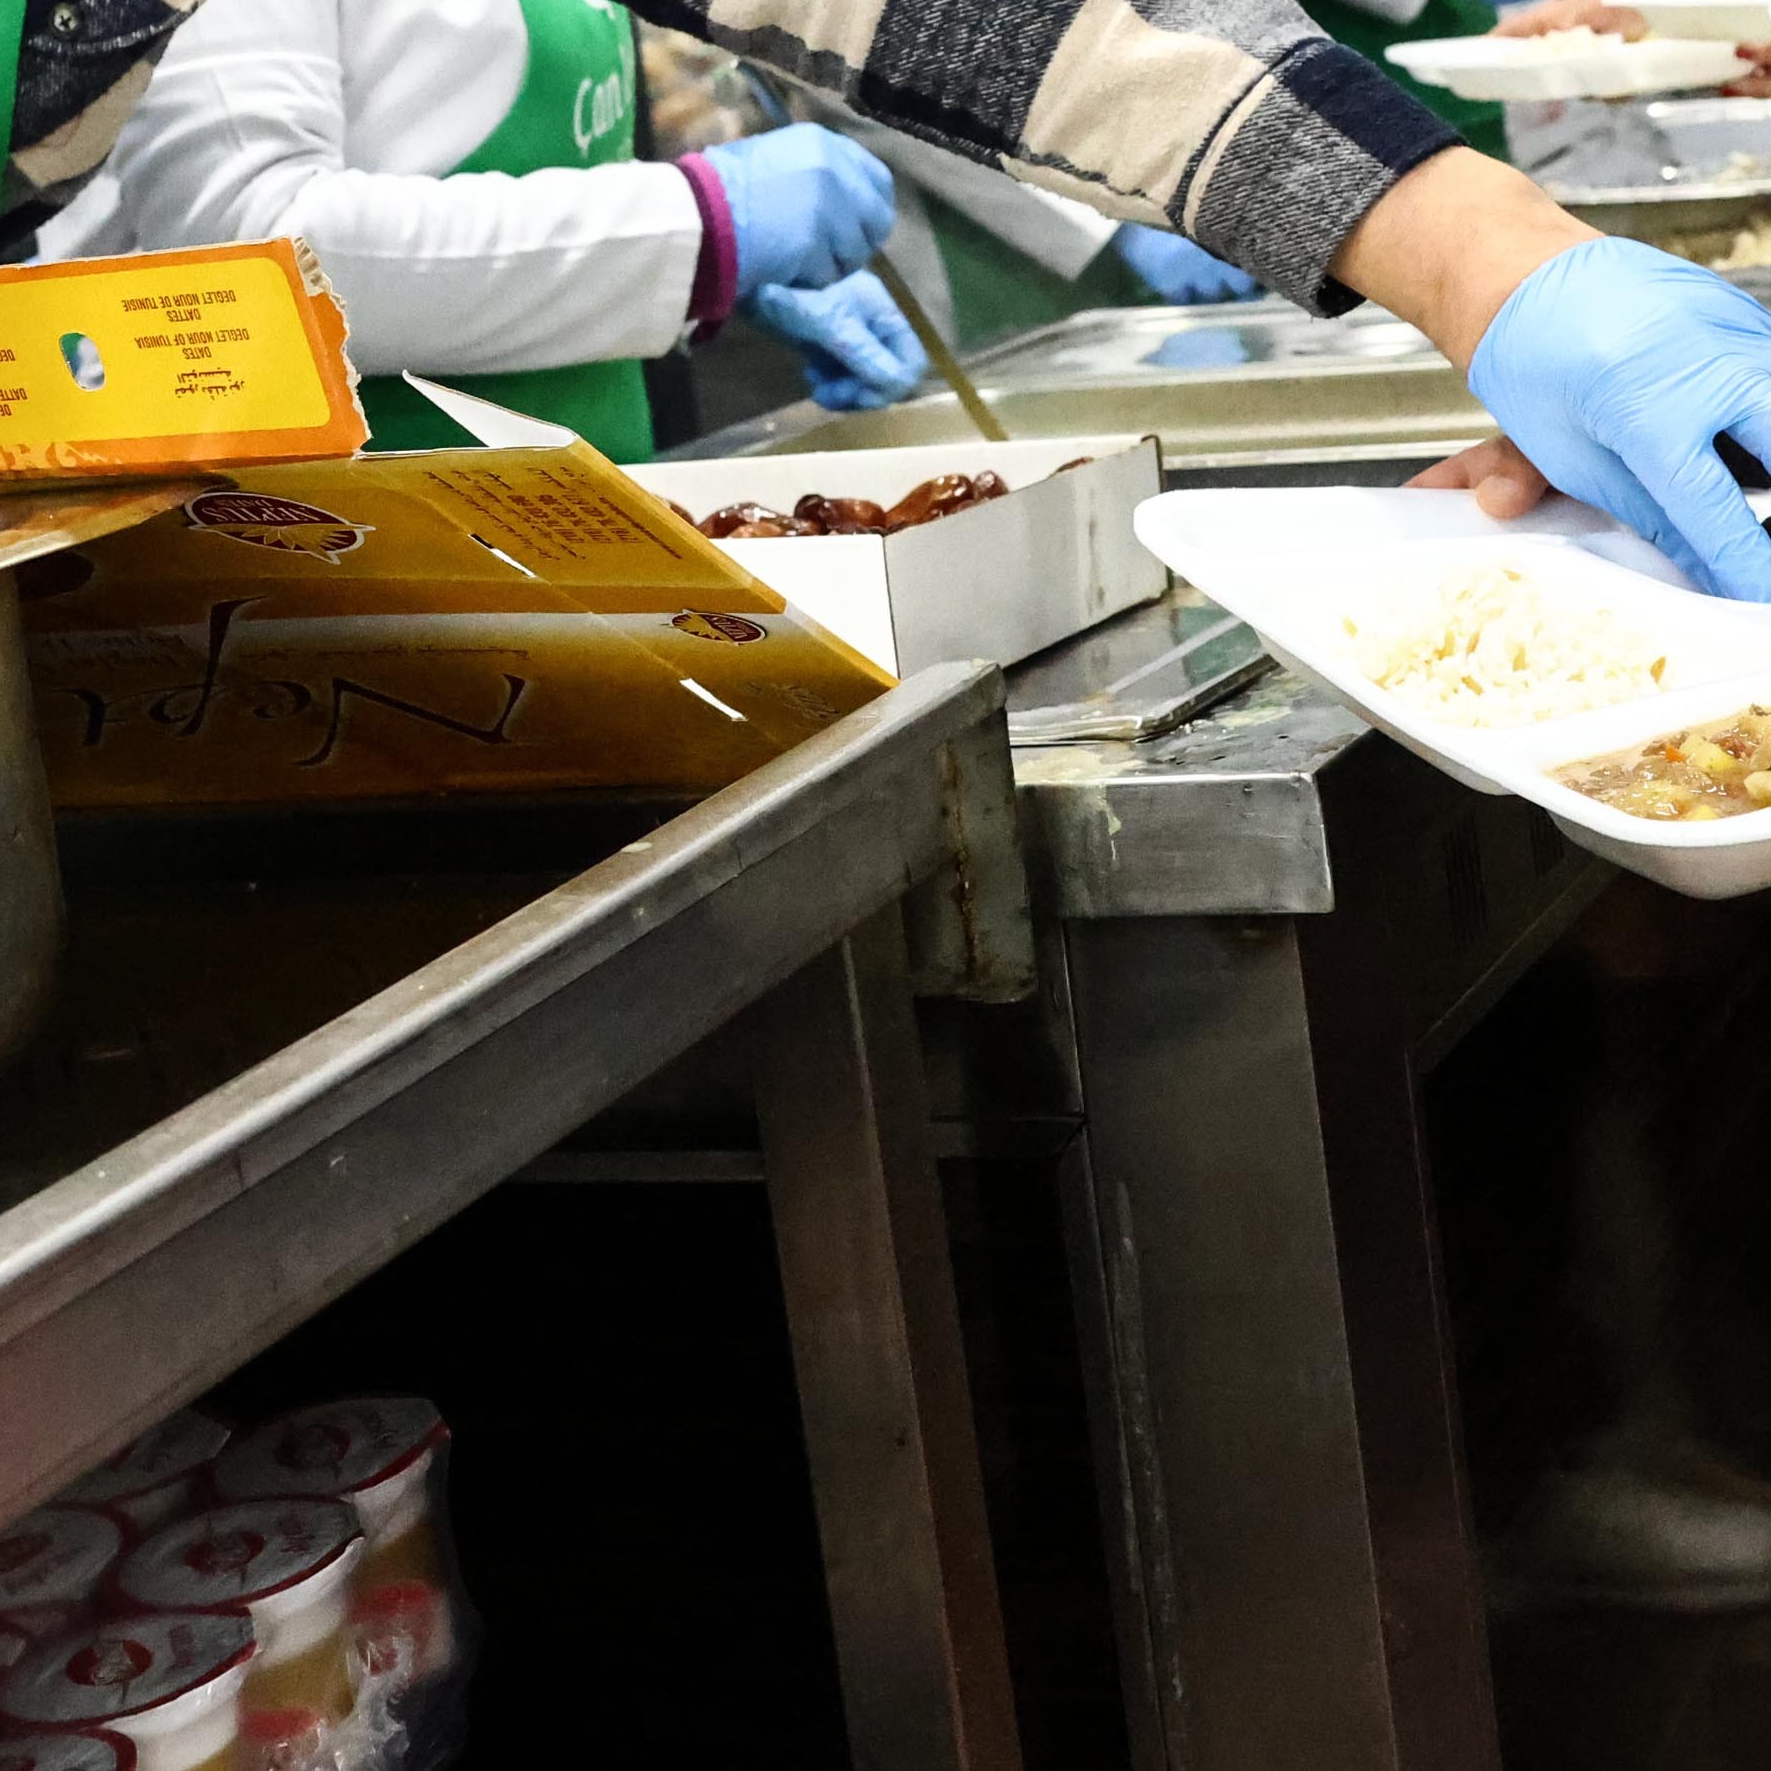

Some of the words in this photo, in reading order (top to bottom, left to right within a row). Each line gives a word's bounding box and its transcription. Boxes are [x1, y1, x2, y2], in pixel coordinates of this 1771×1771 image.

[158, 296, 171, 308] DE
[173, 294, 200, 307] NOUR
[201, 290, 236, 304] DEGLET
[121, 298, 158, 311] TUNISIE
[166, 309, 201, 322] DATTES
[172, 334, 184, 346] OF
[186, 331, 213, 345] NOUR
[215, 328, 249, 342] DEGLET
[134, 335, 171, 349] TUNISIA
[182, 347, 212, 359] DATES
